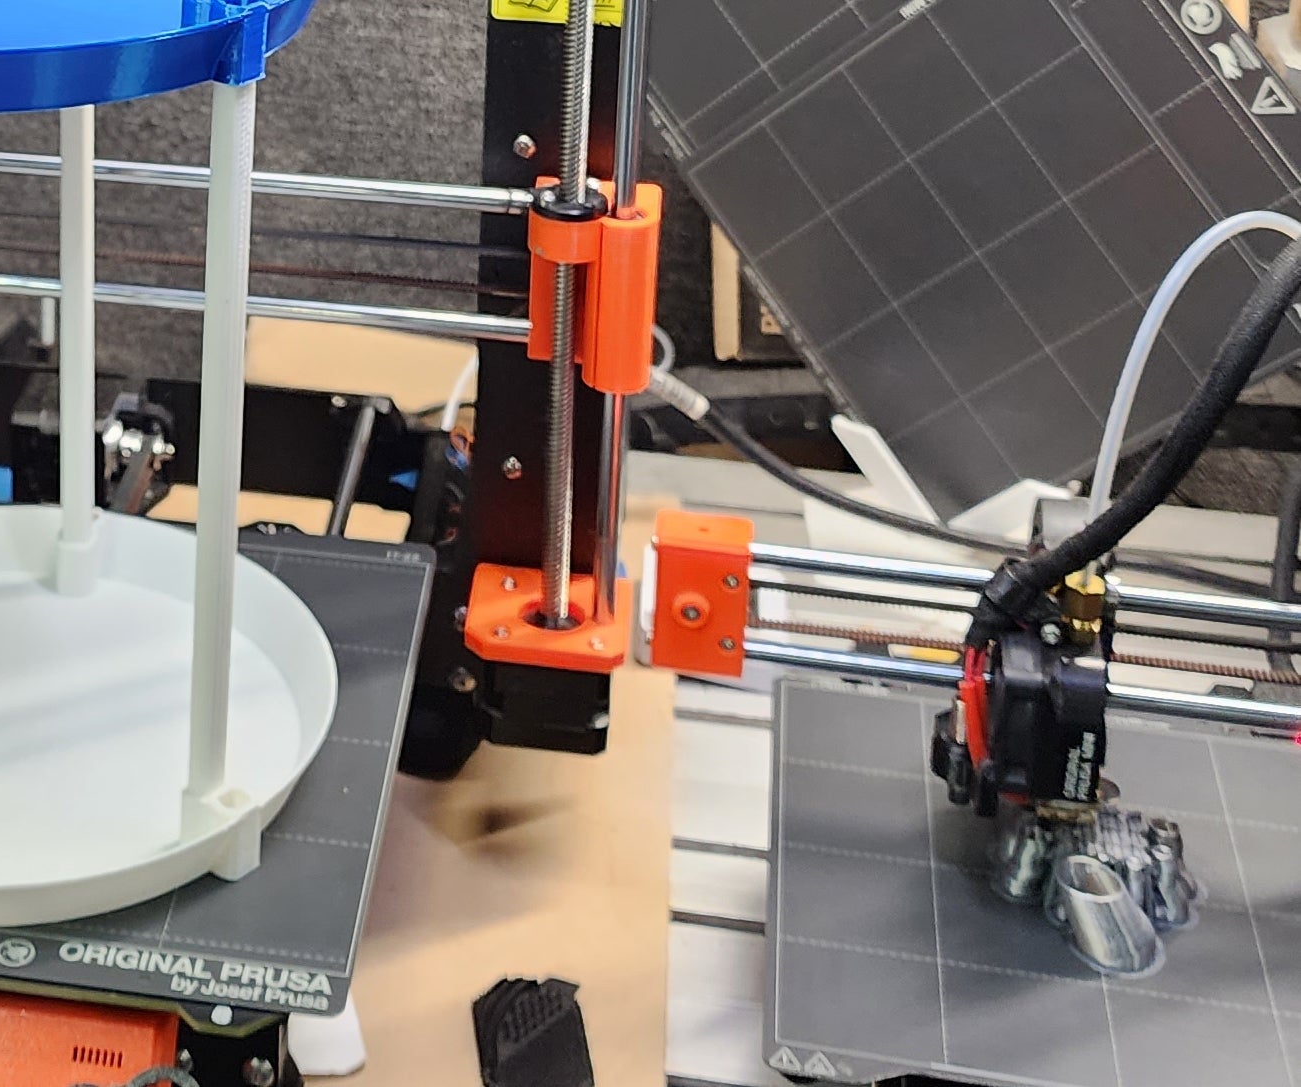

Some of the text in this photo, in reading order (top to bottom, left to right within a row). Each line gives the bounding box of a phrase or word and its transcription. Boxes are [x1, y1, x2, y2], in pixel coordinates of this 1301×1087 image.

[59, 942, 332, 995] ORIGINAL PRUSA
[171, 975, 329, 1010] by Josef Prusa
